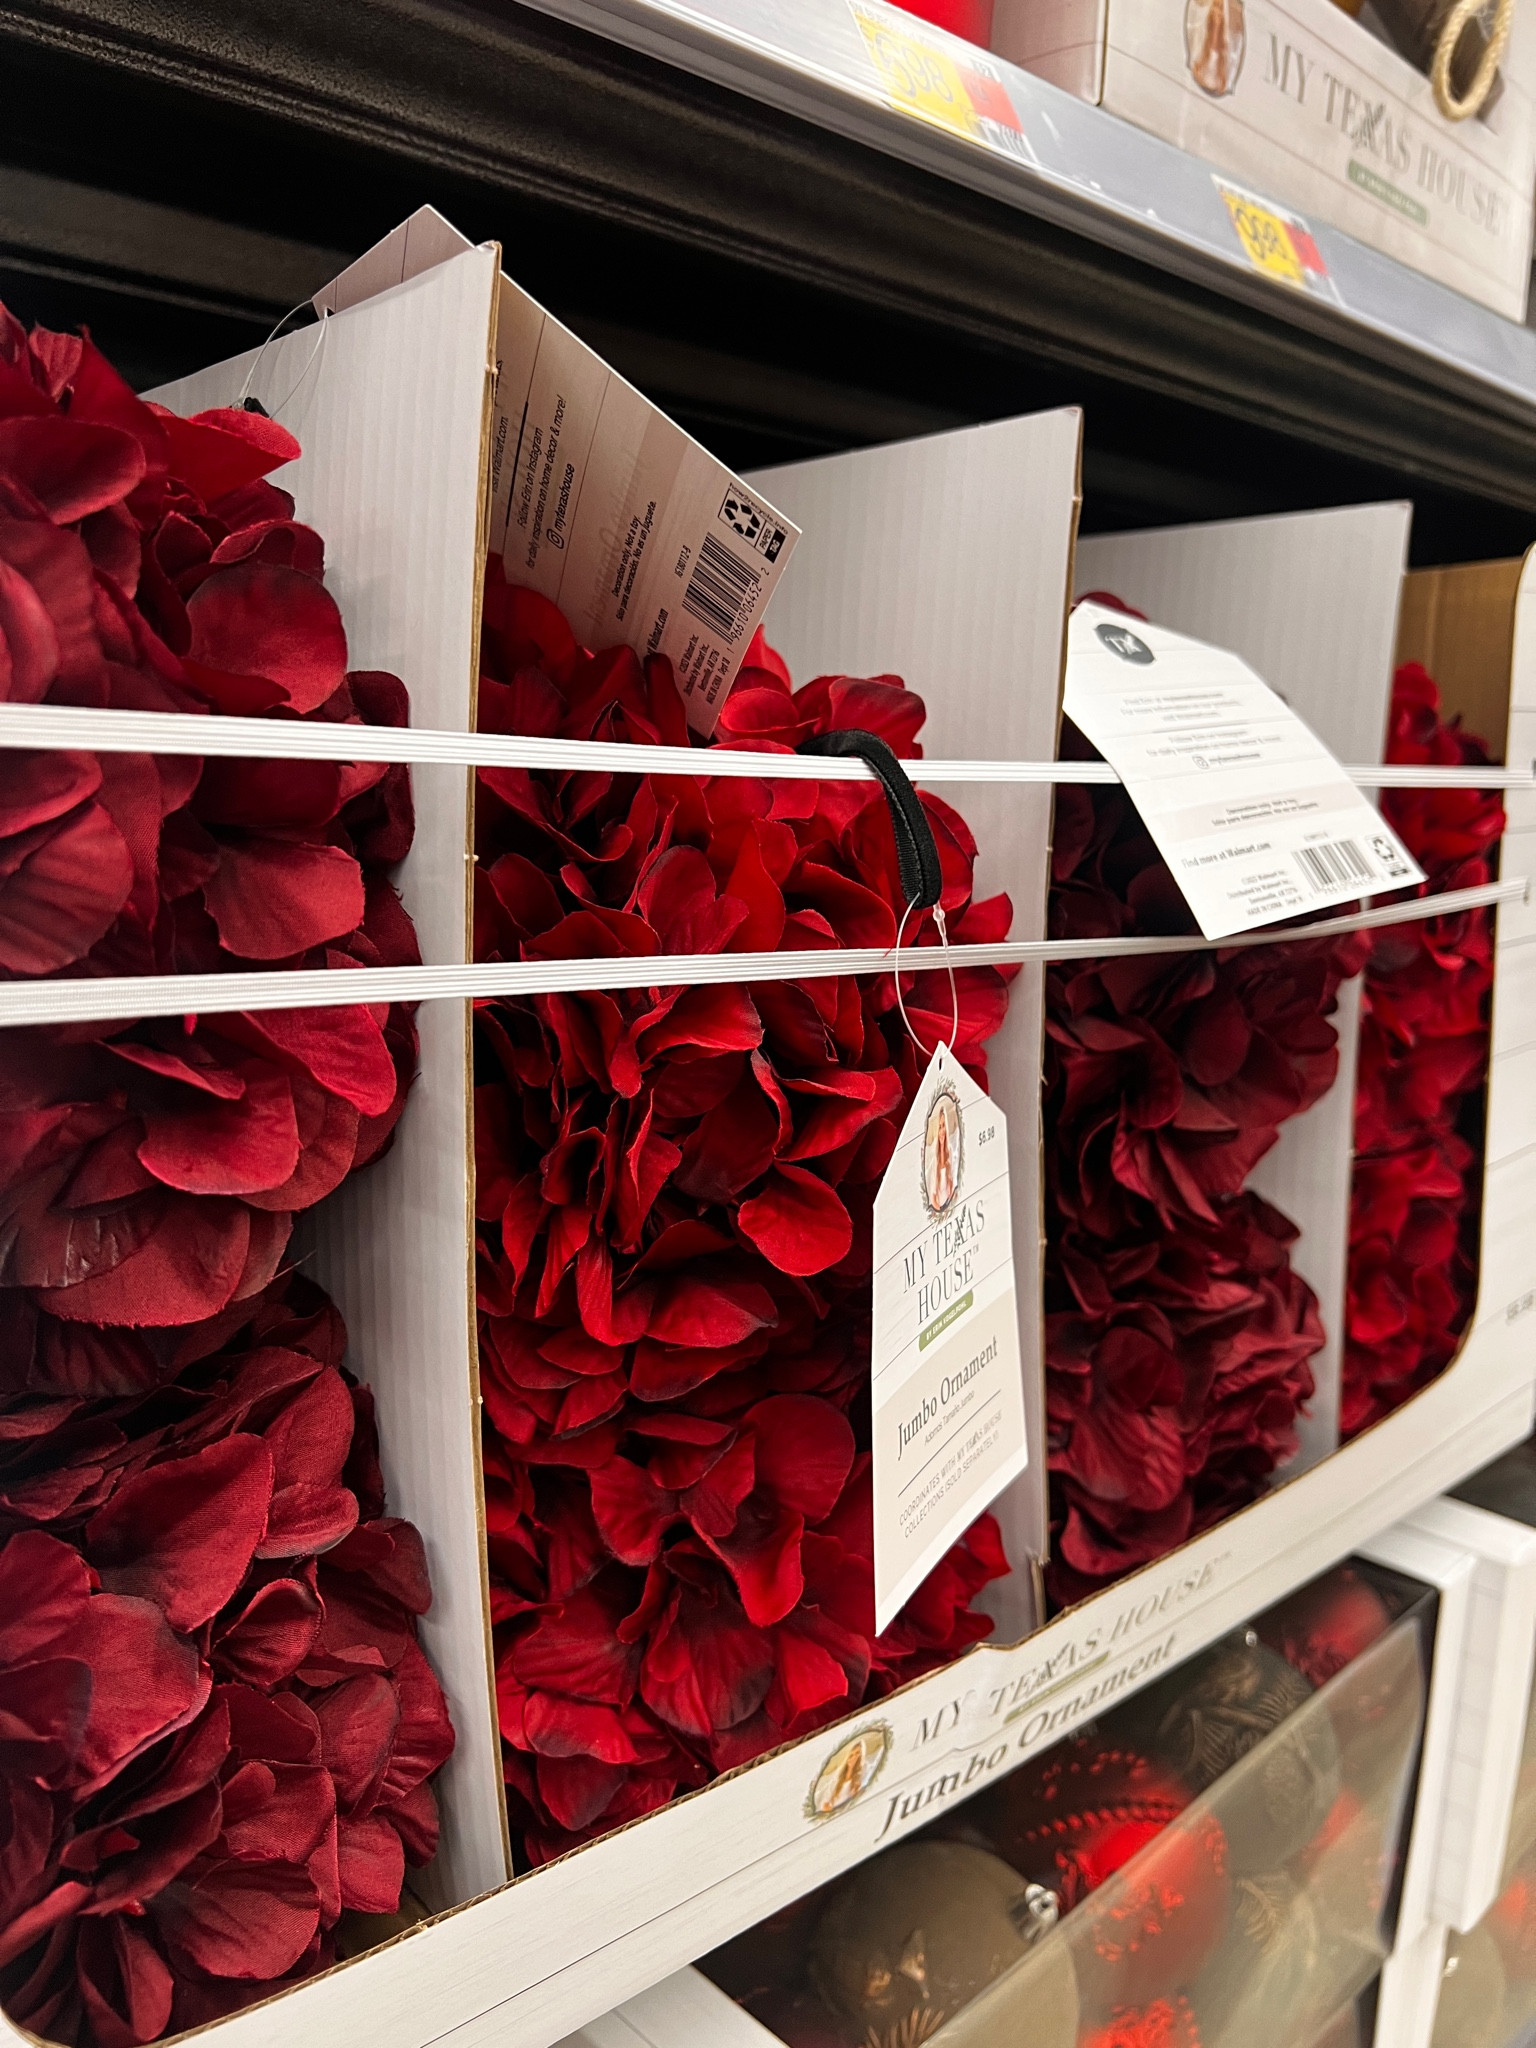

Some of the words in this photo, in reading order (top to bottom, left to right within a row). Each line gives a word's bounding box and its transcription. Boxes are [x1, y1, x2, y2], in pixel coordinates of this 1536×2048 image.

[1264, 31, 1315, 105] MY
[1324, 71, 1411, 175] TEXAS
[554, 394, 567, 428] more!
[550, 427, 560, 436] &
[527, 427, 543, 473] Instagram
[546, 434, 558, 464] decor
[528, 473, 533, 484] on
[540, 464, 552, 490] home
[521, 483, 532, 502] Erin
[540, 492, 546, 501] on
[555, 463, 575, 532] mytexashouse
[519, 500, 530, 528] Follow
[532, 501, 545, 540] inspiration
[631, 515, 643, 529] toy.
[640, 500, 656, 532] juguete.
[625, 533, 635, 548] Not
[637, 539, 645, 549] es
[640, 529, 648, 540] un
[760, 528, 772, 549] PAPER
[770, 539, 781, 553] TAG
[526, 555, 535, 569] for
[529, 539, 541, 559] daily
[622, 549, 631, 564] only.
[632, 548, 642, 559] No
[612, 564, 626, 598] Decoration
[731, 612, 749, 641] 96610
[744, 582, 762, 613] 06452
[761, 567, 770, 576] 2
[903, 1240, 928, 1293] MY
[932, 1199, 985, 1266] TEXAS
[926, 1330, 932, 1341] BY
[932, 1320, 943, 1332] ERIN
[898, 1396, 937, 1461] Jumbo
[940, 1336, 998, 1405] Ornament
[900, 1473, 940, 1526] COORDINATES
[940, 1455, 956, 1478] WITH
[956, 1447, 967, 1464] MY
[904, 1486, 945, 1538] COLLECTIONS
[944, 1467, 962, 1493] (SOLD
[911, 1690, 975, 1754] MY
[987, 1627, 1103, 1718] TEXAS
[875, 1743, 1008, 1844] Jumbo
[1017, 1631, 1179, 1750] Ornament
